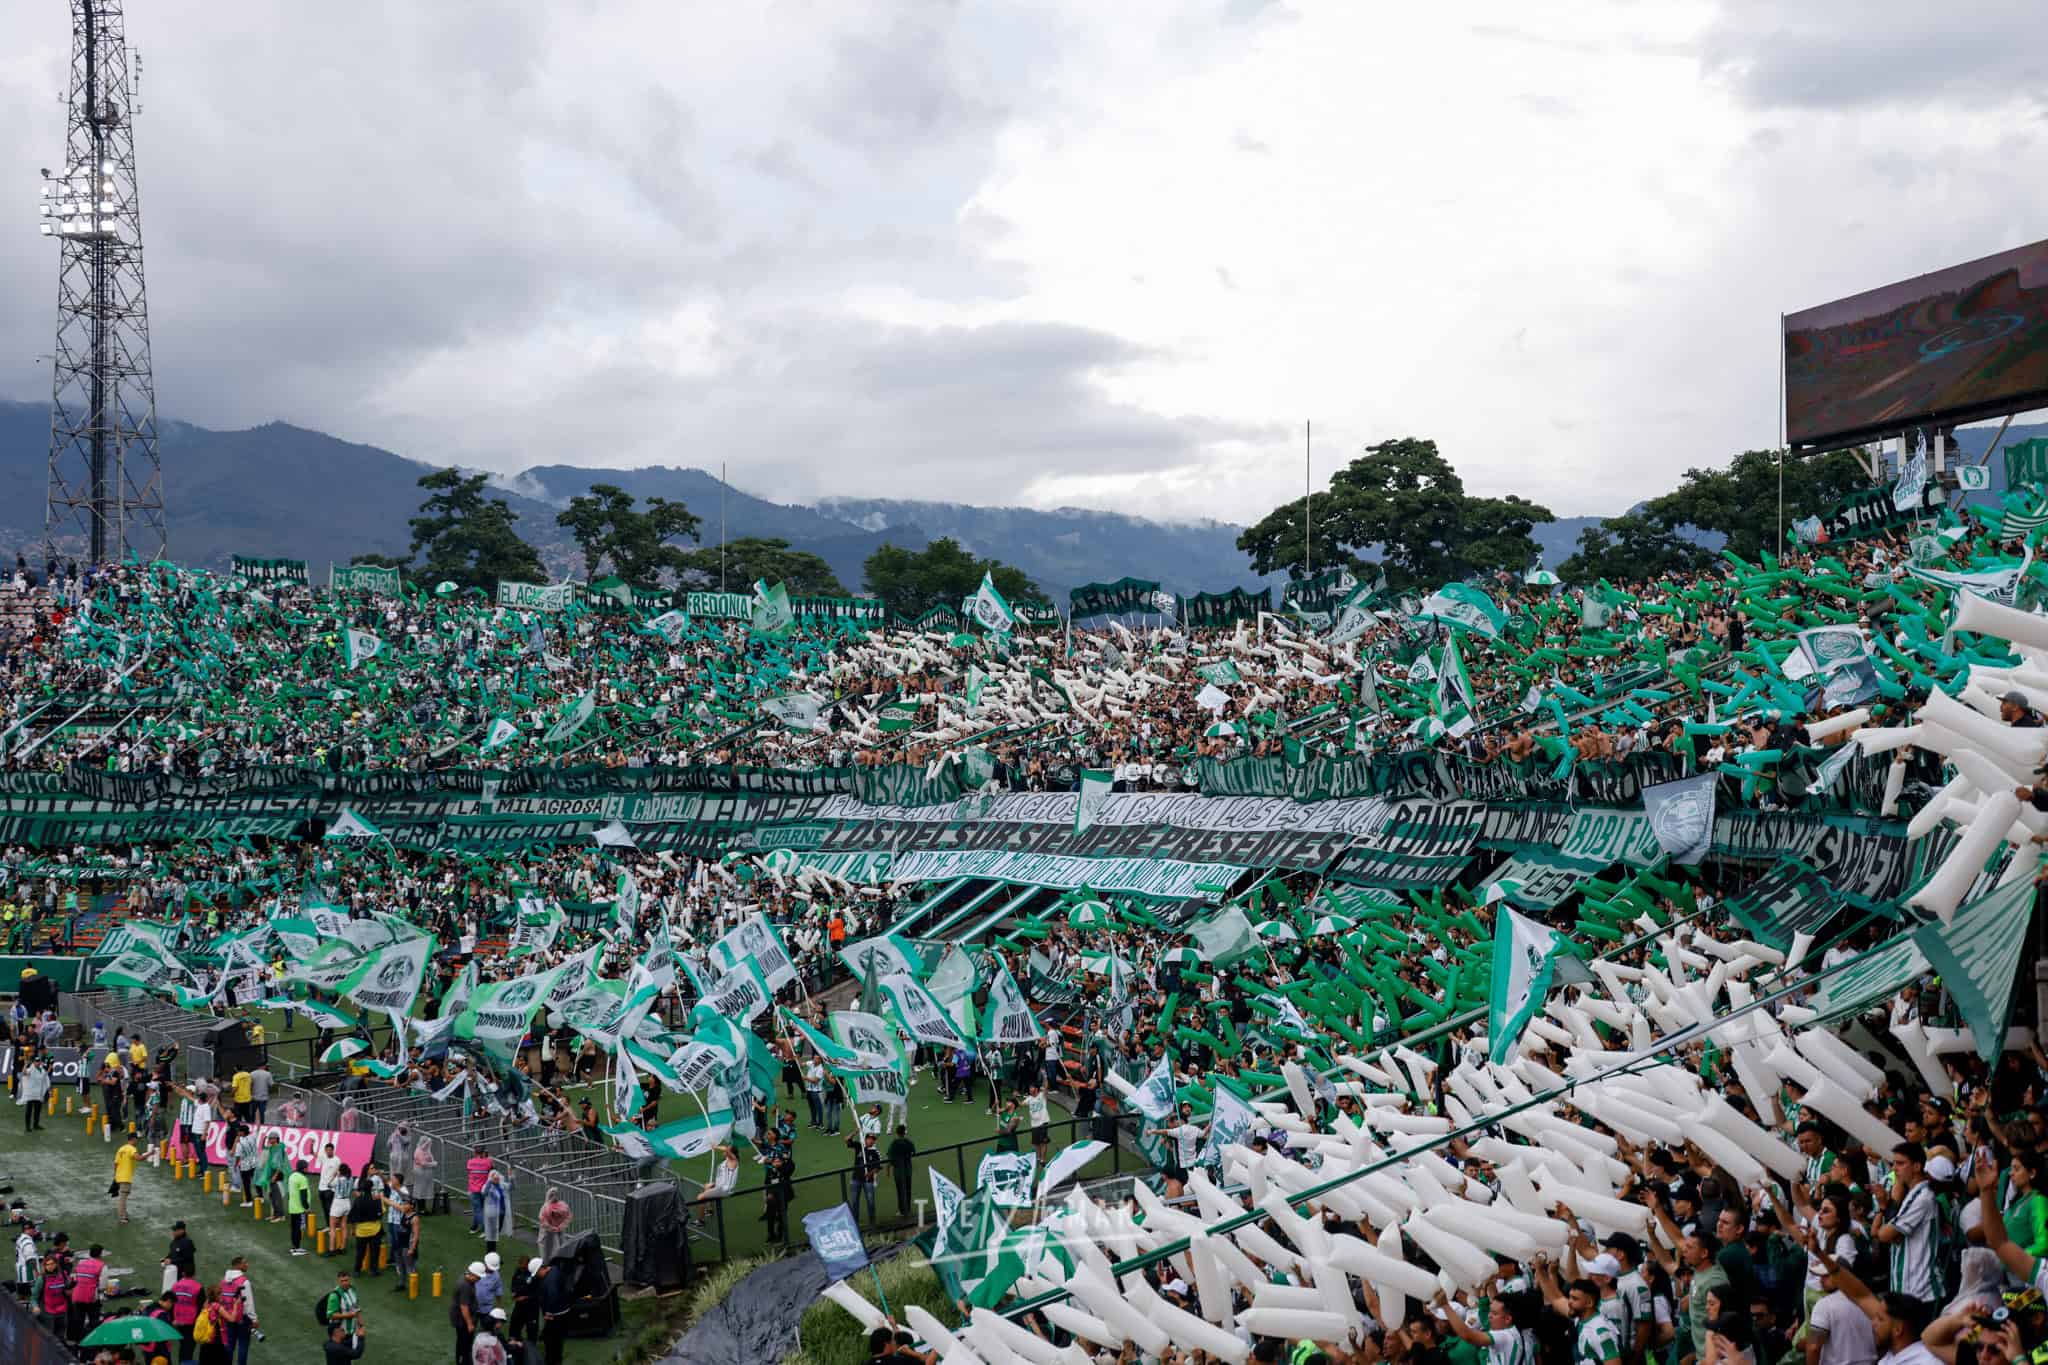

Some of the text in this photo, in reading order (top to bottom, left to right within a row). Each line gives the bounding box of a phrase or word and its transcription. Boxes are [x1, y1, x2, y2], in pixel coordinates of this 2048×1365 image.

[687, 593, 752, 618] FREDONIA
[457, 798, 604, 816] LA MILAGROSA
[606, 797, 625, 819] EL
[632, 795, 700, 821] CARMELO
[1120, 794, 1214, 831] BARRA
[1211, 797, 1276, 832] LOS
[227, 817, 299, 842] CEJA
[443, 822, 580, 843] ENVIGADO
[760, 828, 825, 849] GUARNE
[820, 821, 1343, 873] LOS DEL SUR SIEMPRE PRESENTES
[205, 1121, 340, 1169] POTOBON
